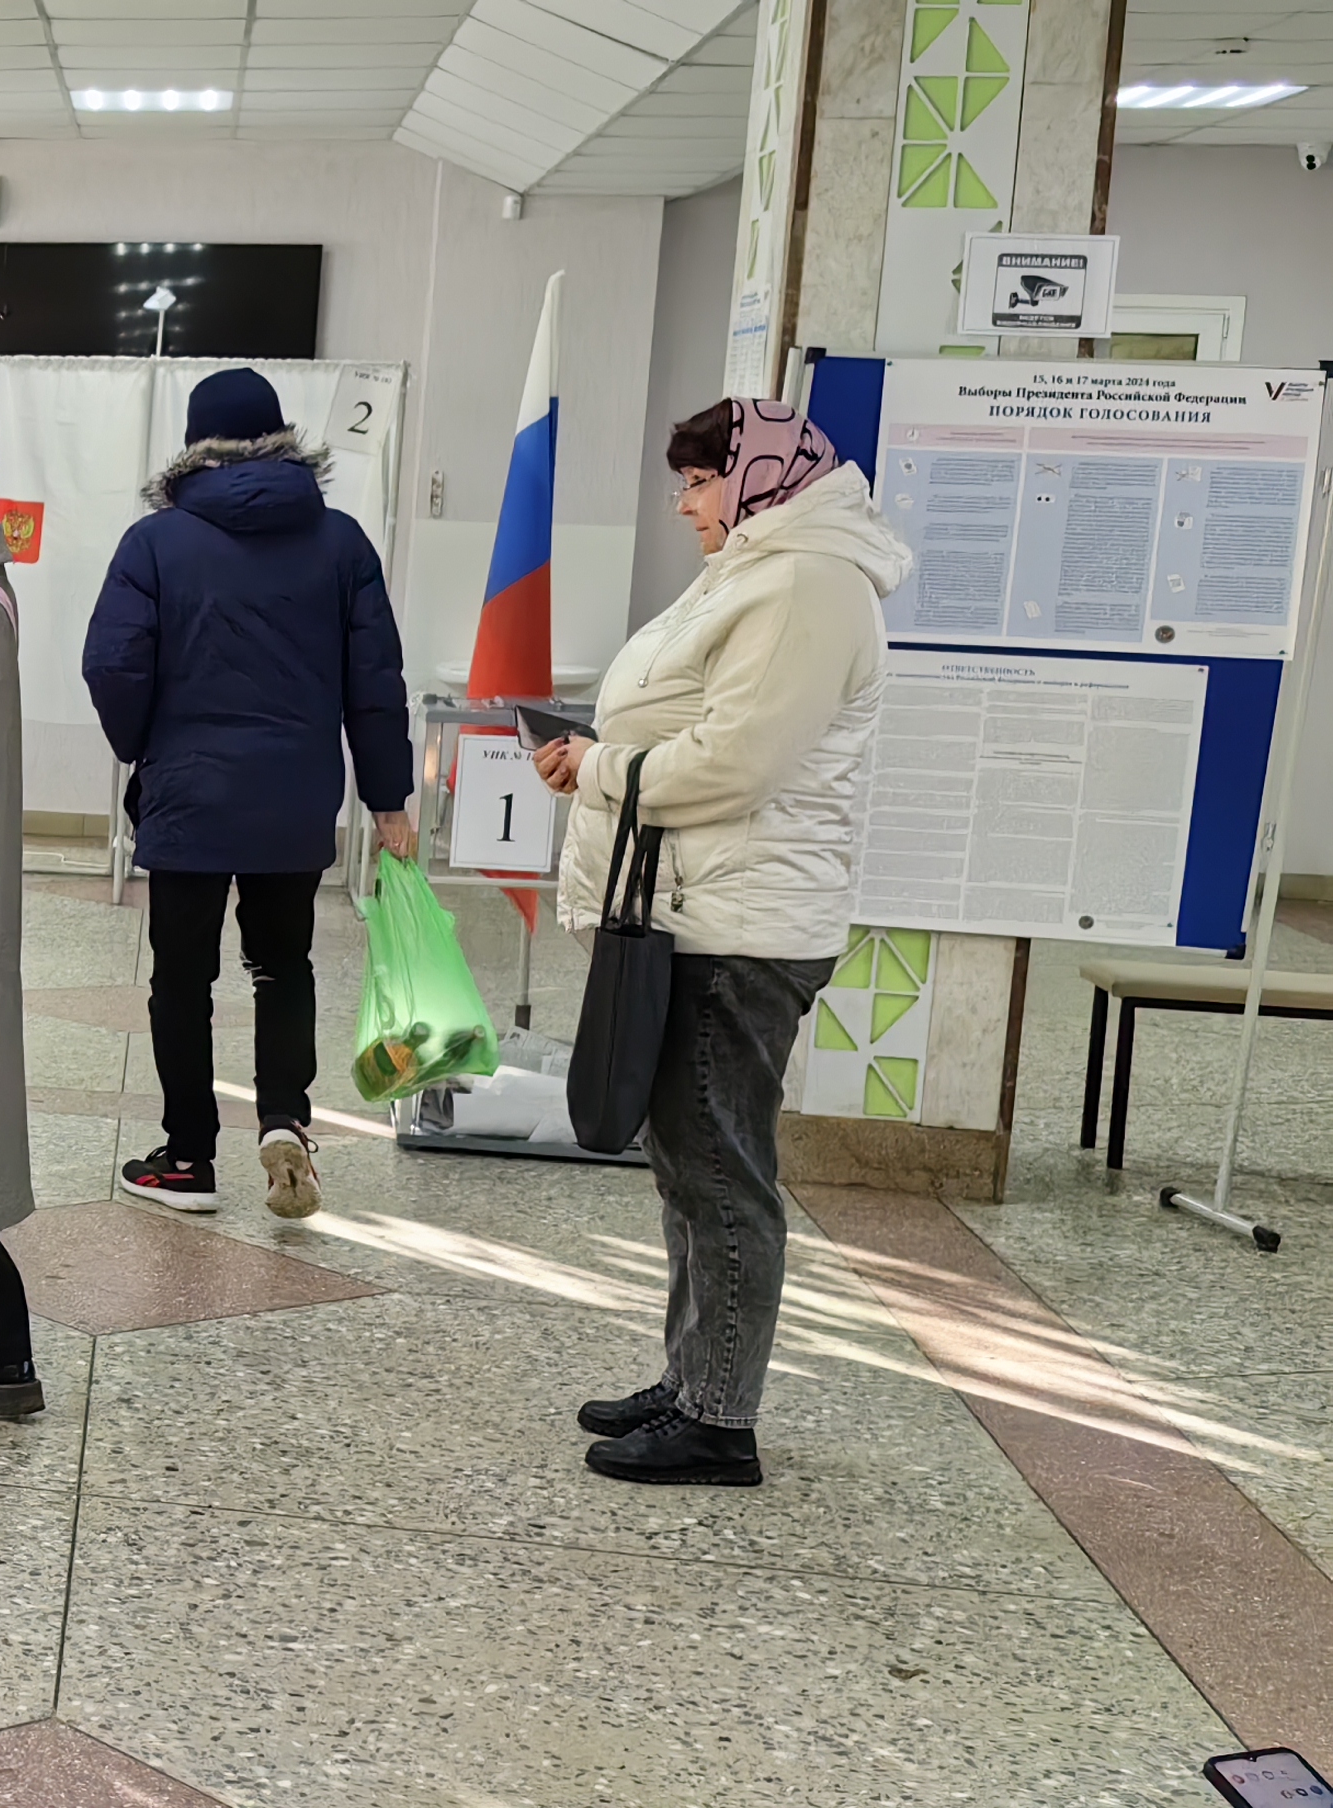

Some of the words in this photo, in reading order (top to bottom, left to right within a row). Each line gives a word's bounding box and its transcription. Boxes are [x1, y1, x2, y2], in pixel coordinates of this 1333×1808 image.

[1052, 375, 1064, 385] 16
[1077, 376, 1089, 385] 17
[1091, 378, 1123, 388] марта
[1125, 378, 1150, 387] 2024
[1152, 380, 1176, 389] года
[958, 385, 1013, 401] Выборы
[1015, 387, 1094, 401] Президента
[1096, 389, 1171, 403] Российской
[1174, 392, 1248, 407] Федерации
[347, 401, 374, 435] 2
[989, 404, 1074, 421] ПОРЯДОК
[1079, 407, 1212, 423] ГОЛОСОВАНИЯ
[483, 750, 510, 760] УИК
[495, 792, 516, 843] 1
